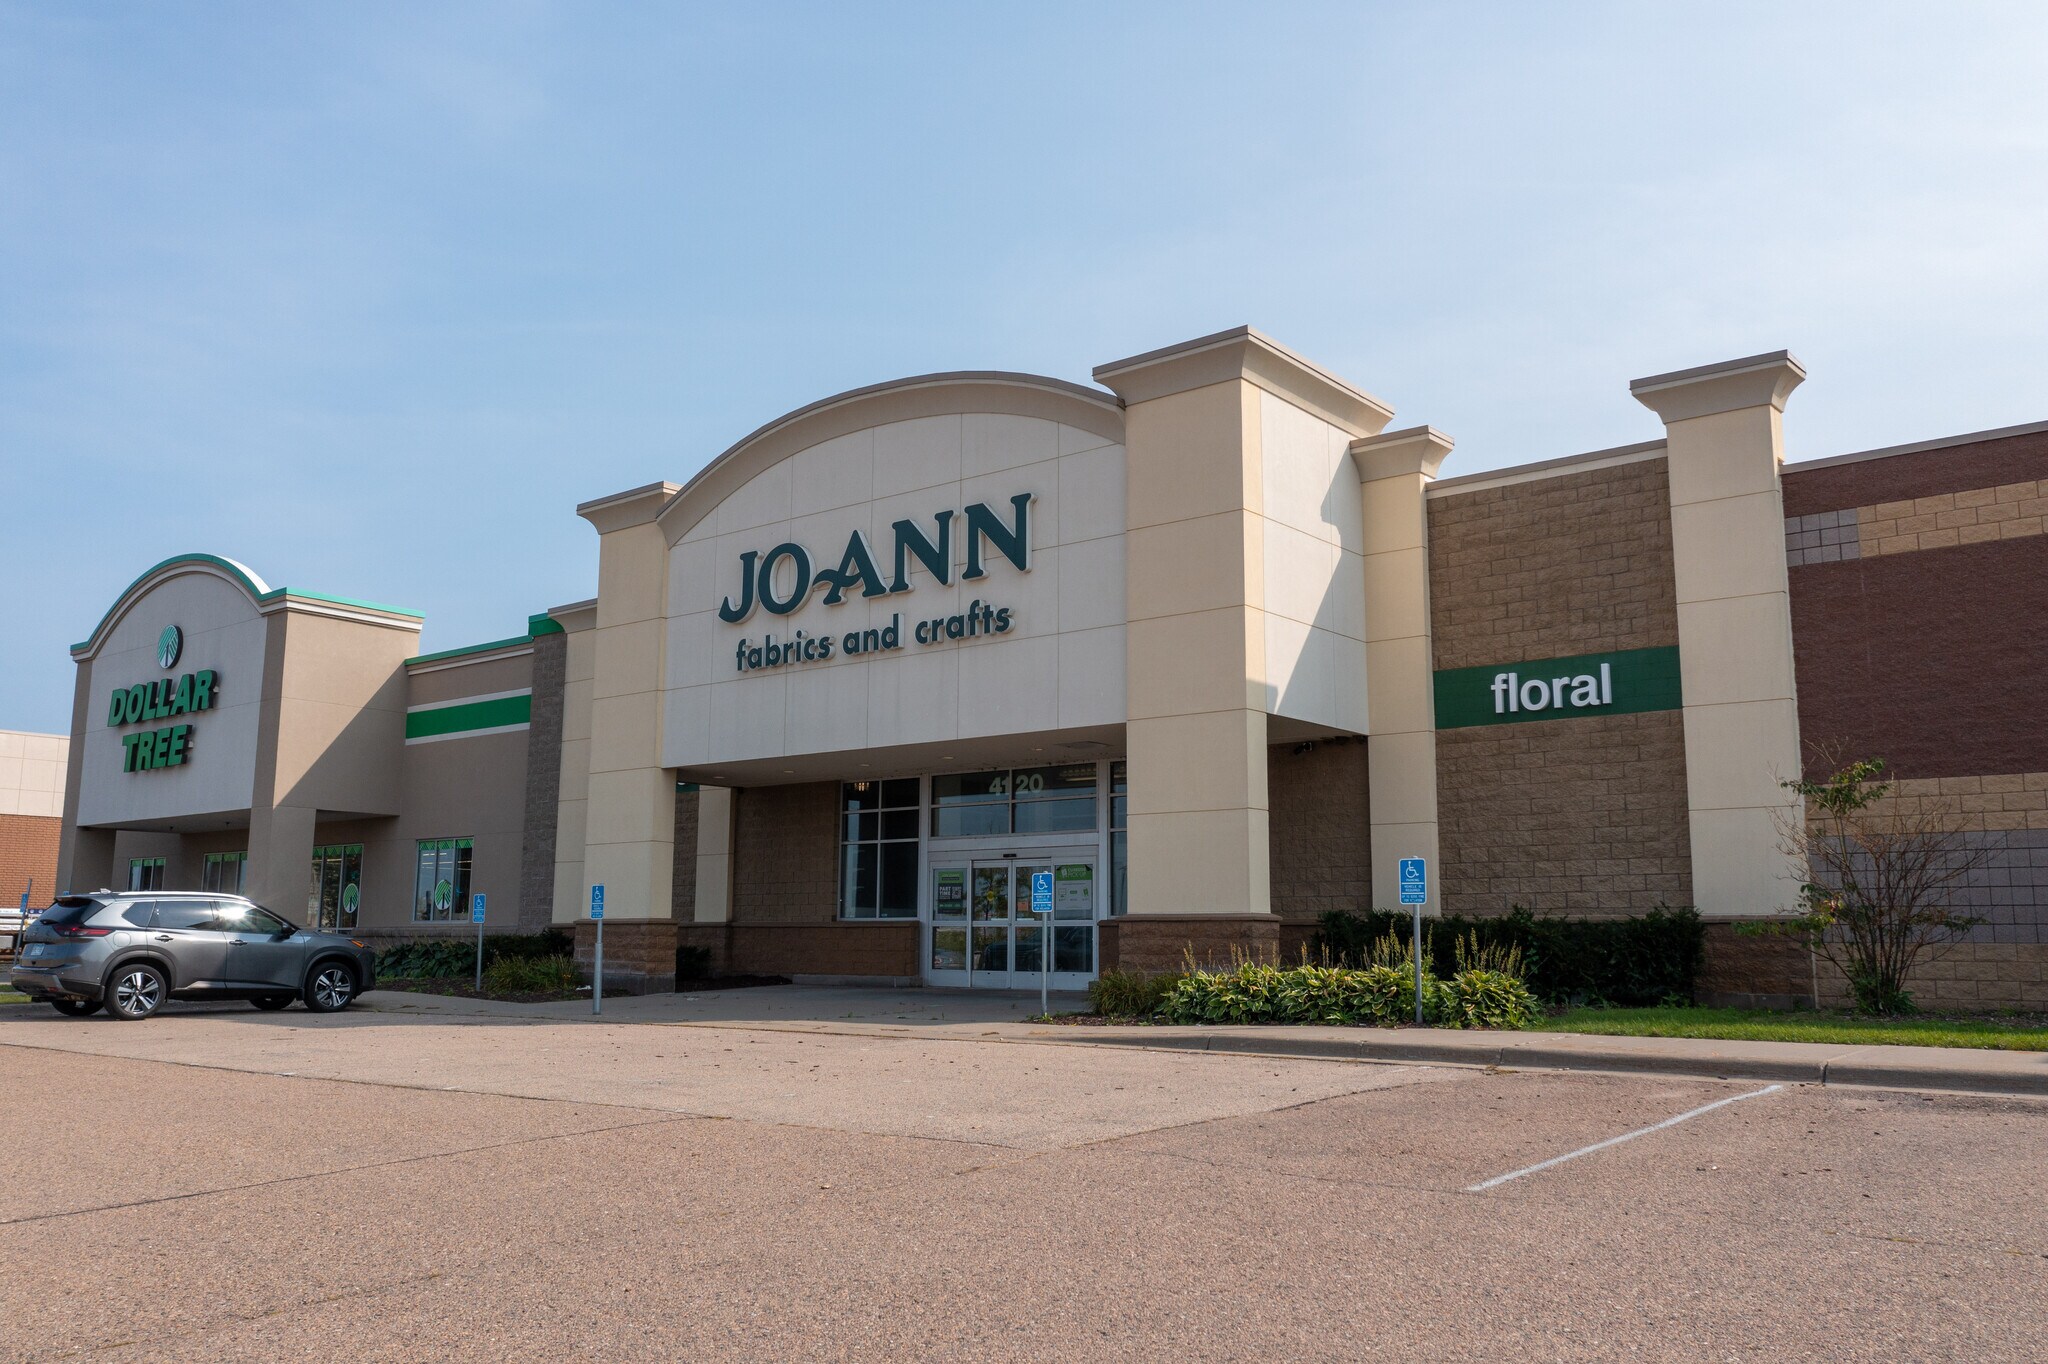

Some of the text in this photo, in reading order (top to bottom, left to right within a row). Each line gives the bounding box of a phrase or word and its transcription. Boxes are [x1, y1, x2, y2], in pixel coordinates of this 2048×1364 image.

[718, 493, 1036, 624] JOANN
[736, 600, 1016, 672] fabrics and crafts
[107, 669, 217, 727] DOLLAR
[1491, 663, 1612, 713] floral
[122, 724, 192, 773] TREE
[989, 773, 1044, 796] 4120
